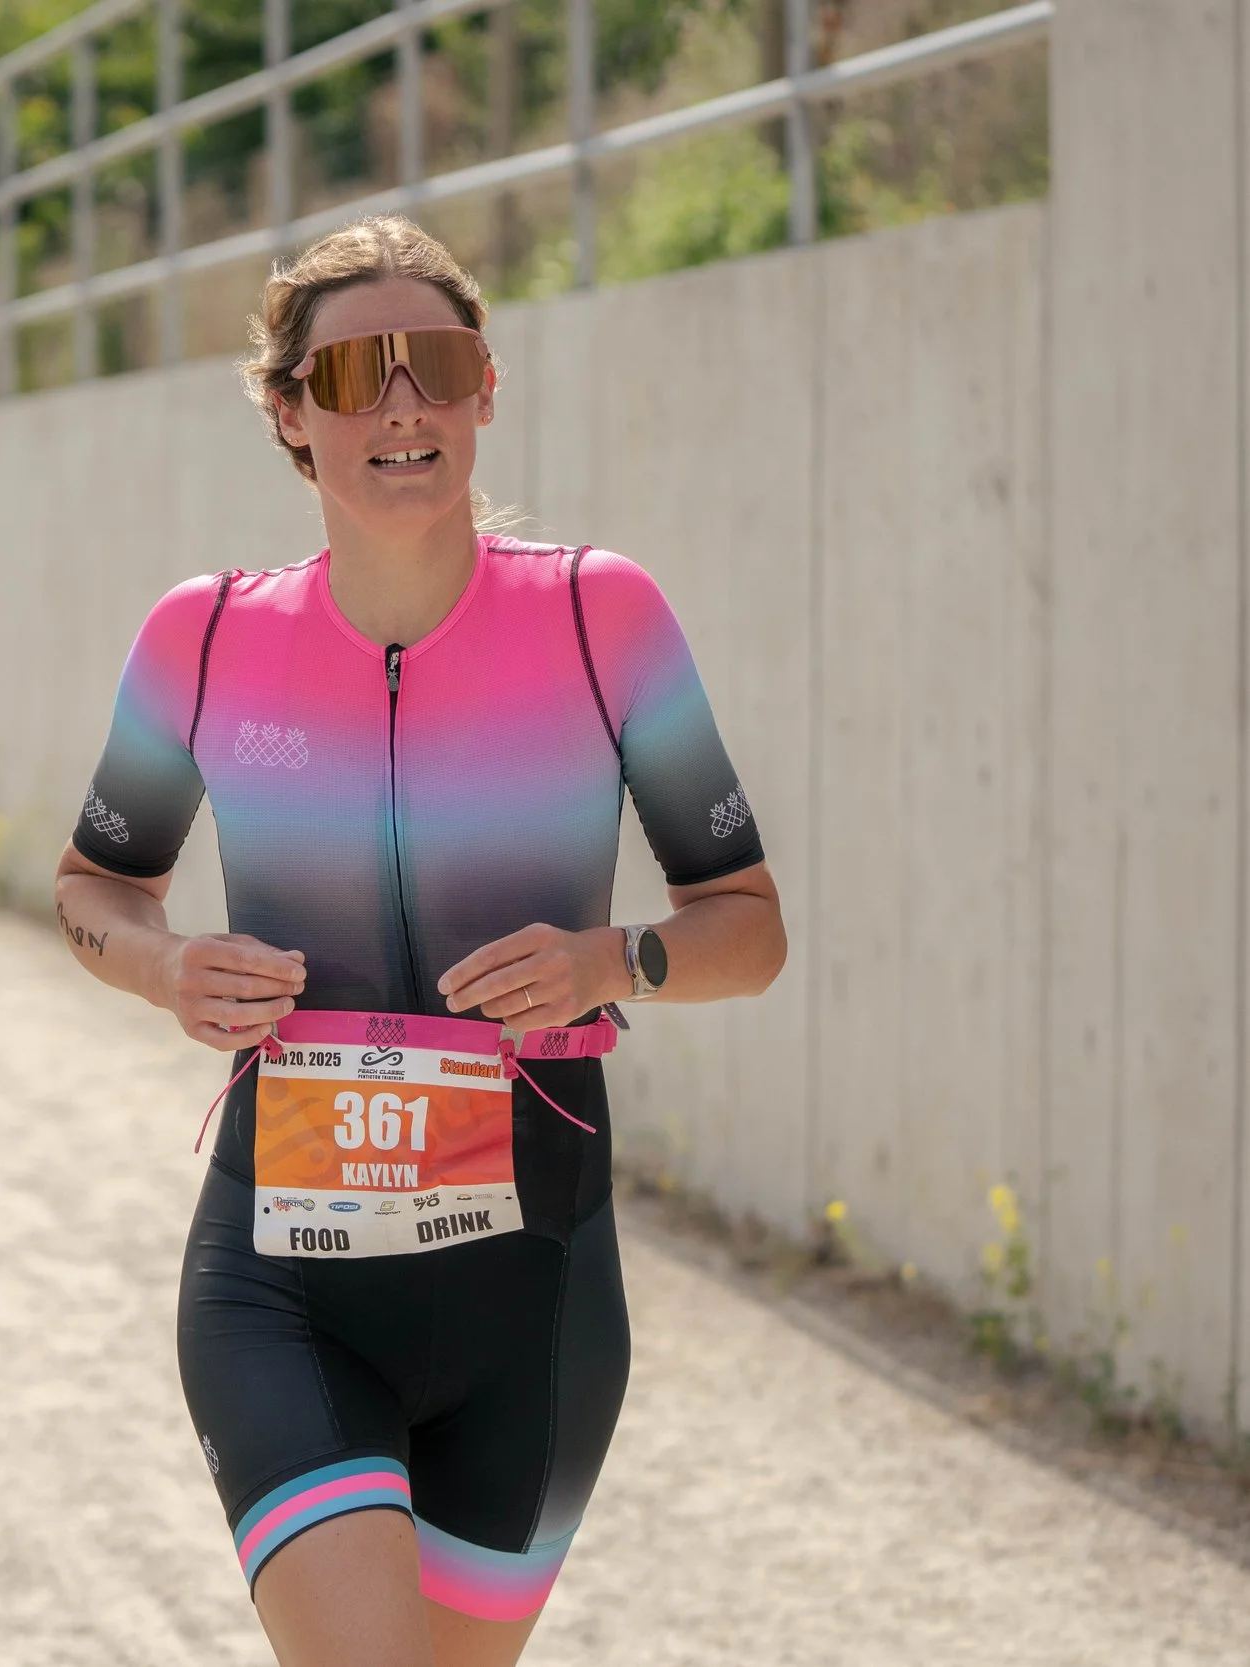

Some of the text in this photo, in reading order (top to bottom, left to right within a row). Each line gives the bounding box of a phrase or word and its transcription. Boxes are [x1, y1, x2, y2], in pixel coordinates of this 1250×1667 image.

[290, 1051, 306, 1067] 20,
[309, 1052, 342, 1067] 2025
[440, 1058, 501, 1080] Standard
[333, 1091, 429, 1152] 361
[341, 1162, 419, 1188] KAYLYN
[413, 1192, 439, 1203] BLUE
[414, 1197, 441, 1212] 70
[416, 1209, 493, 1244] DRINK
[289, 1227, 351, 1252] FOOD
